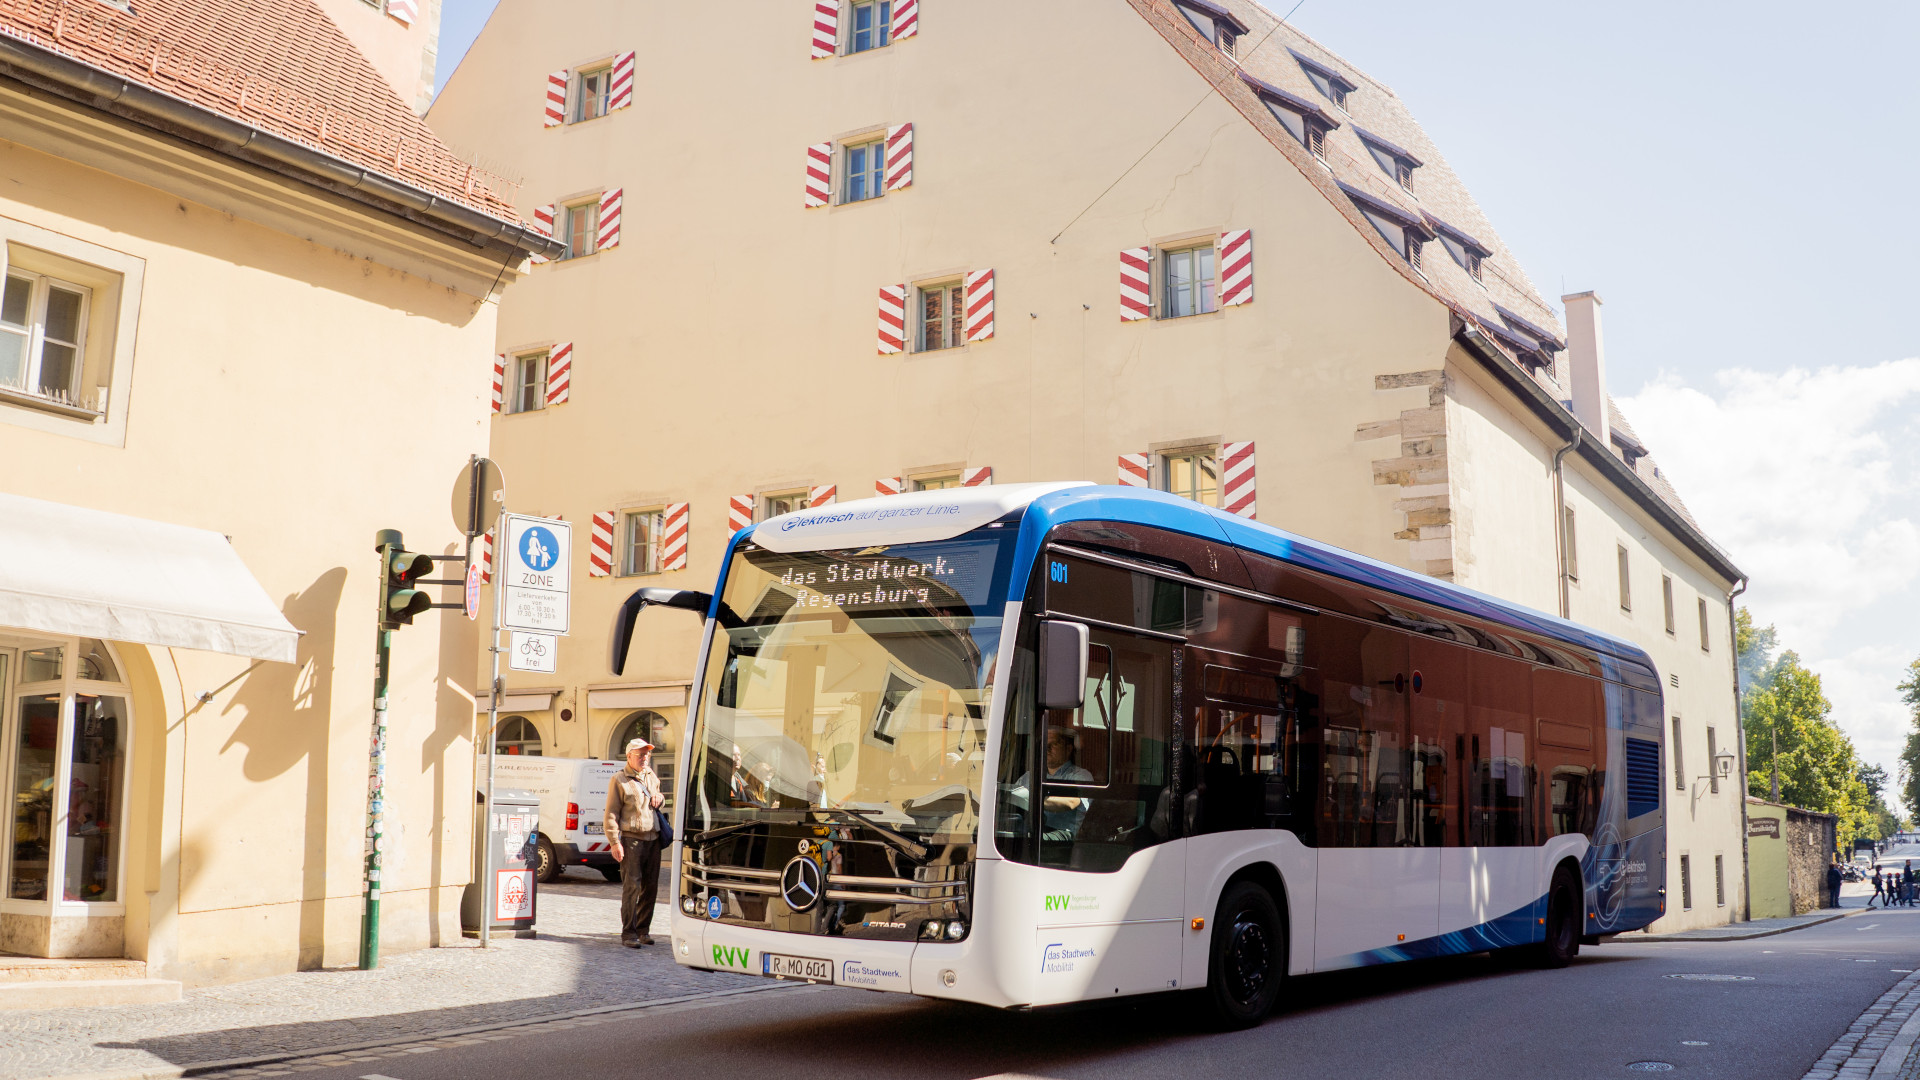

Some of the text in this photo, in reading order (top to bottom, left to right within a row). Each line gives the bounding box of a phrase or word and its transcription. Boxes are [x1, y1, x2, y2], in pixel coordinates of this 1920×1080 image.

[856, 509, 879, 521] auf
[879, 505, 923, 521] ganzer
[926, 503, 961, 516] Linie.
[781, 555, 955, 586] das Stadtwerk.
[1050, 561, 1068, 584] 601
[522, 573, 553, 587] ZONE
[517, 592, 557, 601] Lieferverkehr
[795, 584, 929, 609] Regensburg
[525, 657, 540, 667] frei
[1045, 895, 1070, 911] RVV
[712, 944, 750, 969] RVV
[1047, 948, 1096, 960] das Stadtwerk.
[773, 957, 827, 978] R MO 601
[847, 966, 902, 978] das Stadtwerk.
[1046, 962, 1074, 973] Mobilität
[848, 975, 877, 985] Mobilität
